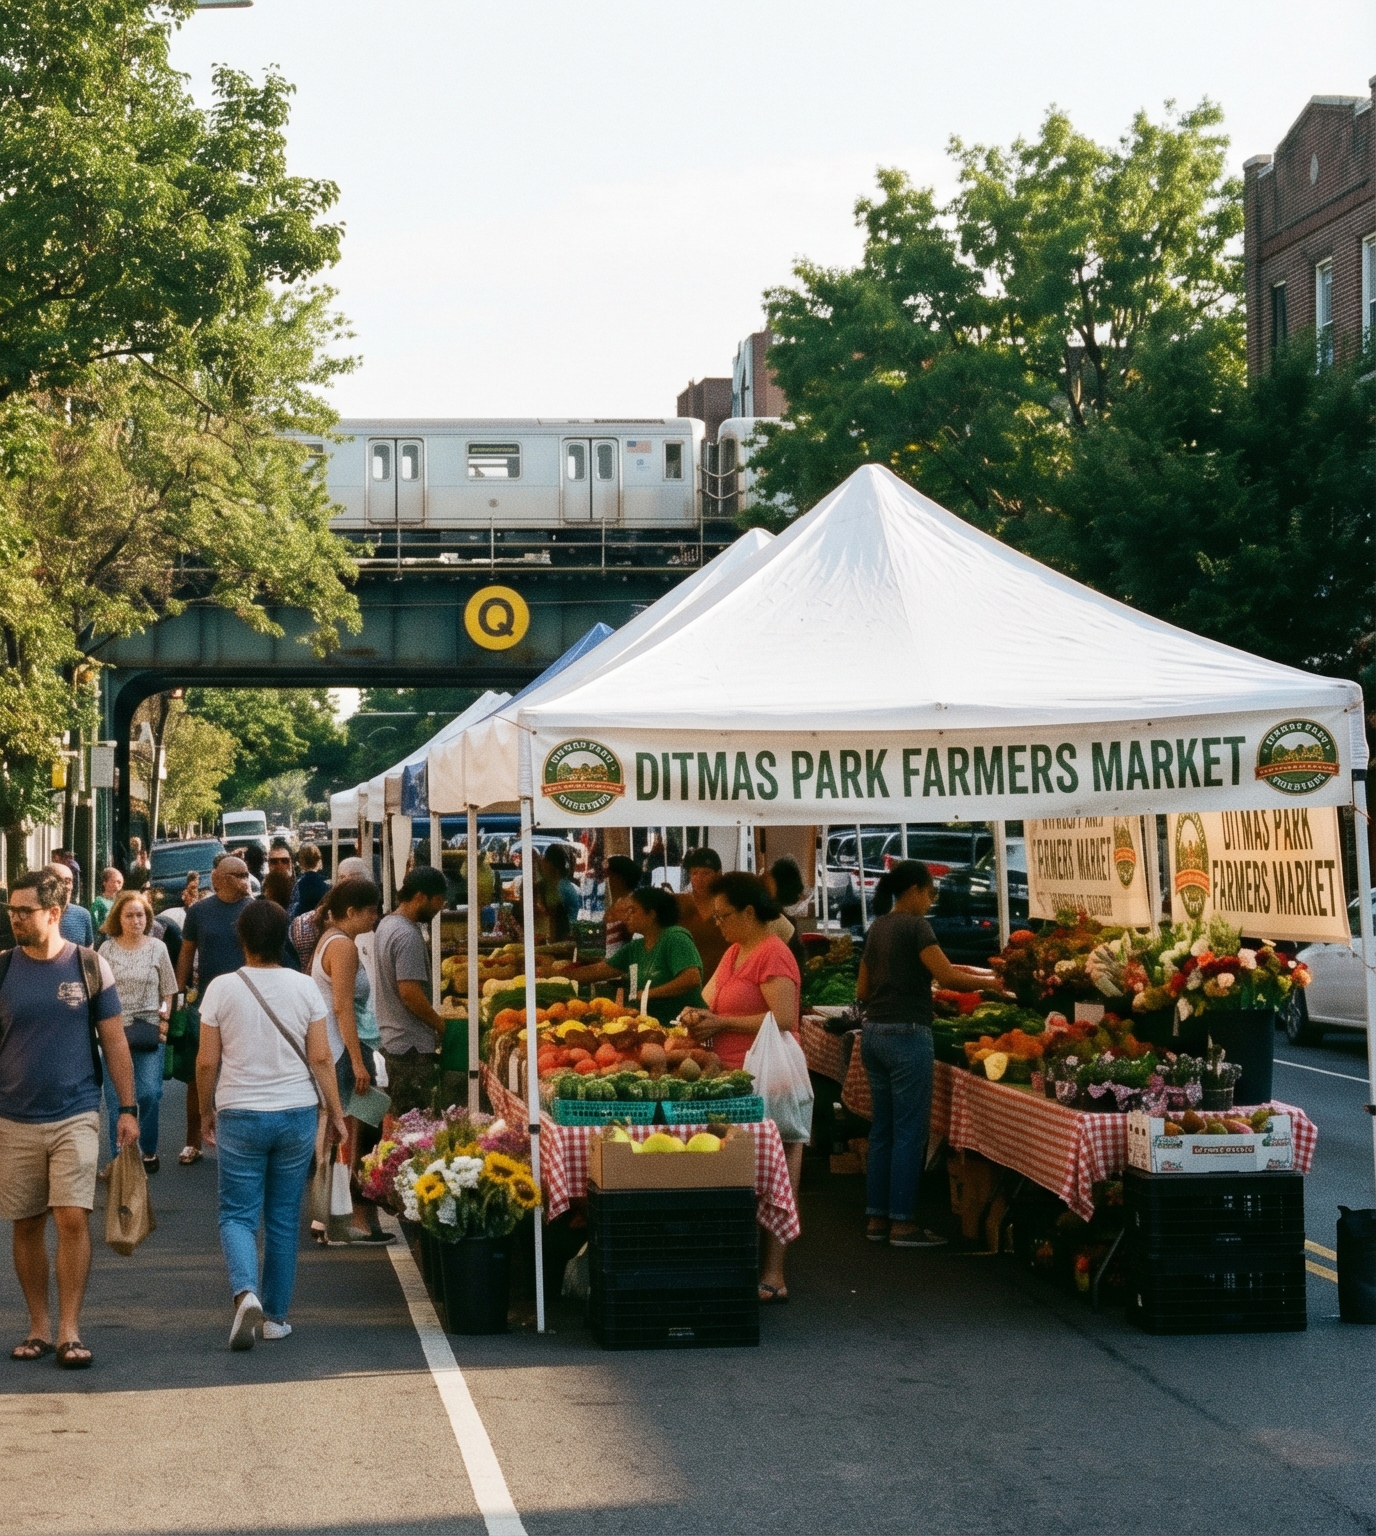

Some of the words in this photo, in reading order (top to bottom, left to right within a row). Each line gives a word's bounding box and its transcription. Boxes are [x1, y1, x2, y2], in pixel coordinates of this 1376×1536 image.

[478, 597, 515, 638] Q
[635, 749, 779, 801] DITMAS
[791, 748, 890, 800] PARK
[902, 742, 1079, 798] FARMERS
[1091, 735, 1246, 792] MARKET
[1273, 807, 1314, 851] PARK
[1212, 859, 1271, 915] FARMERS
[1272, 859, 1337, 917] MARKET
